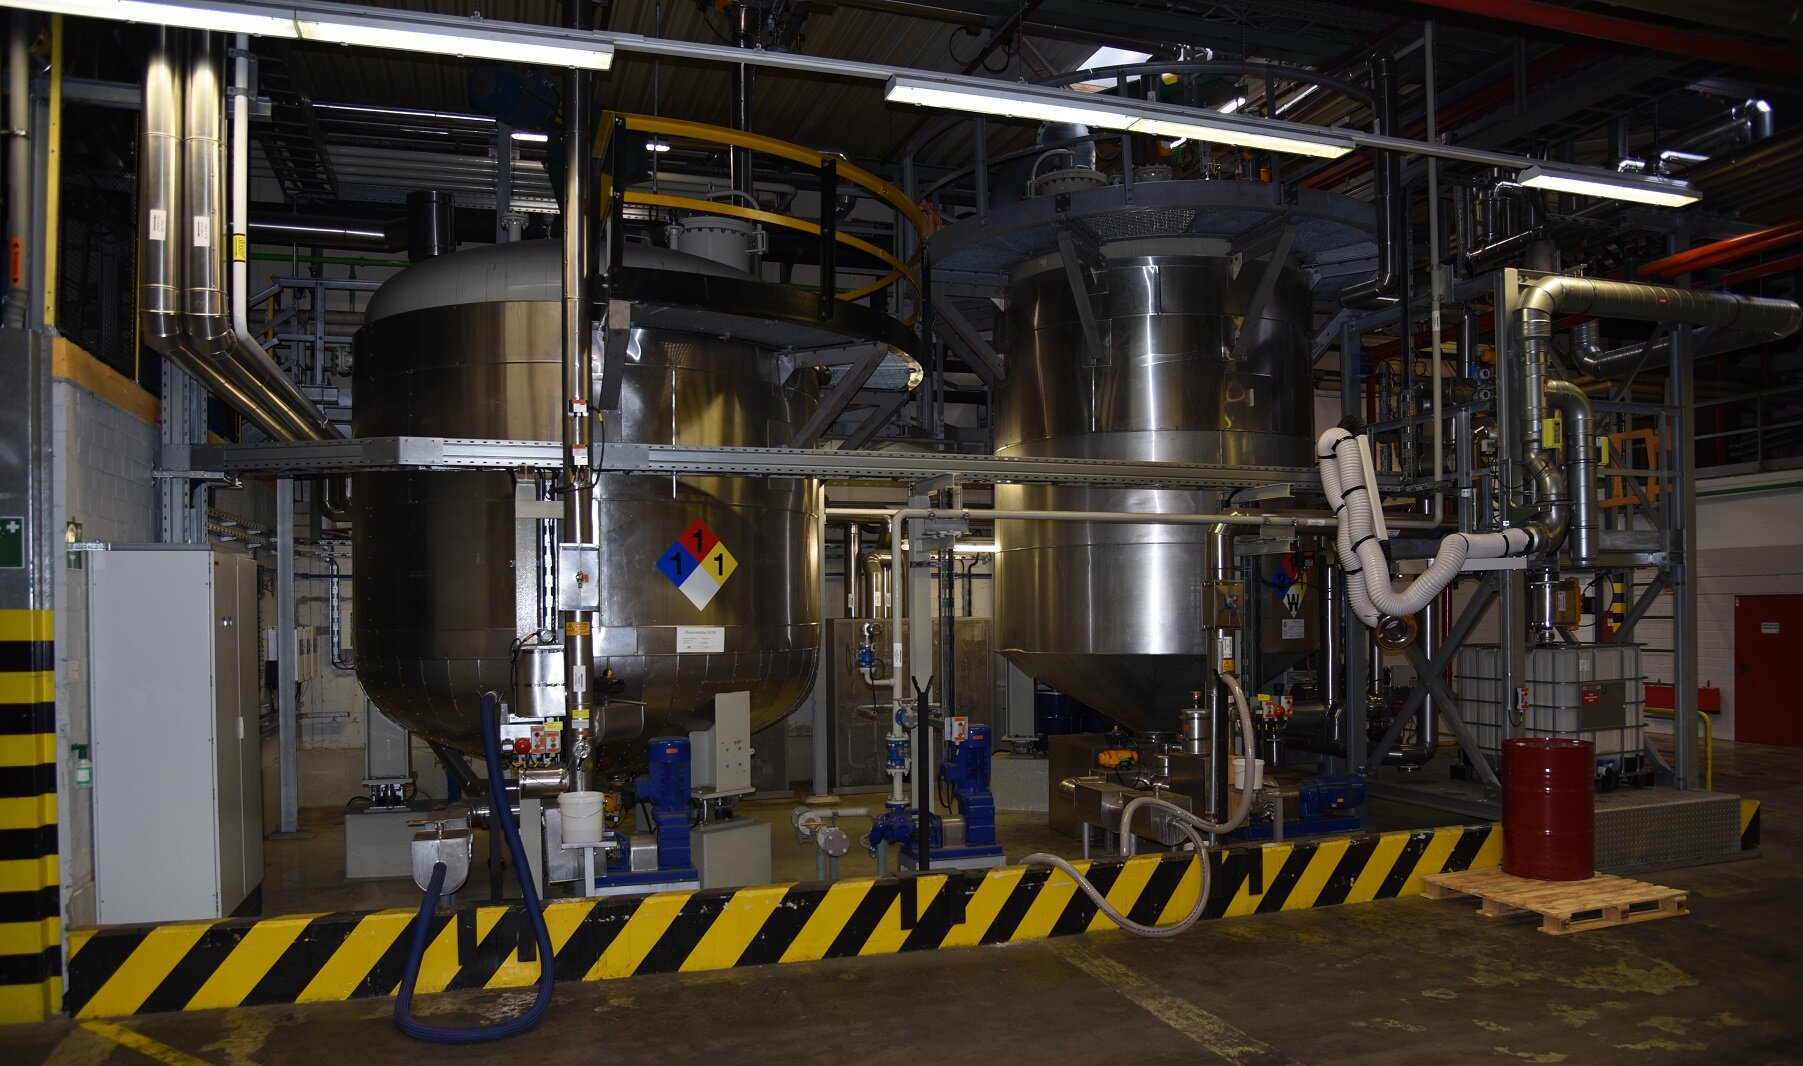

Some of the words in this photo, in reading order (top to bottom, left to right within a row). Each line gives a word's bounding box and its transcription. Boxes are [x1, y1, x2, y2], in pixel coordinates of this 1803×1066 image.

[693, 529, 702, 552] 1
[671, 552, 682, 575] 1
[714, 553, 723, 575] 1
[1287, 594, 1299, 611] W
